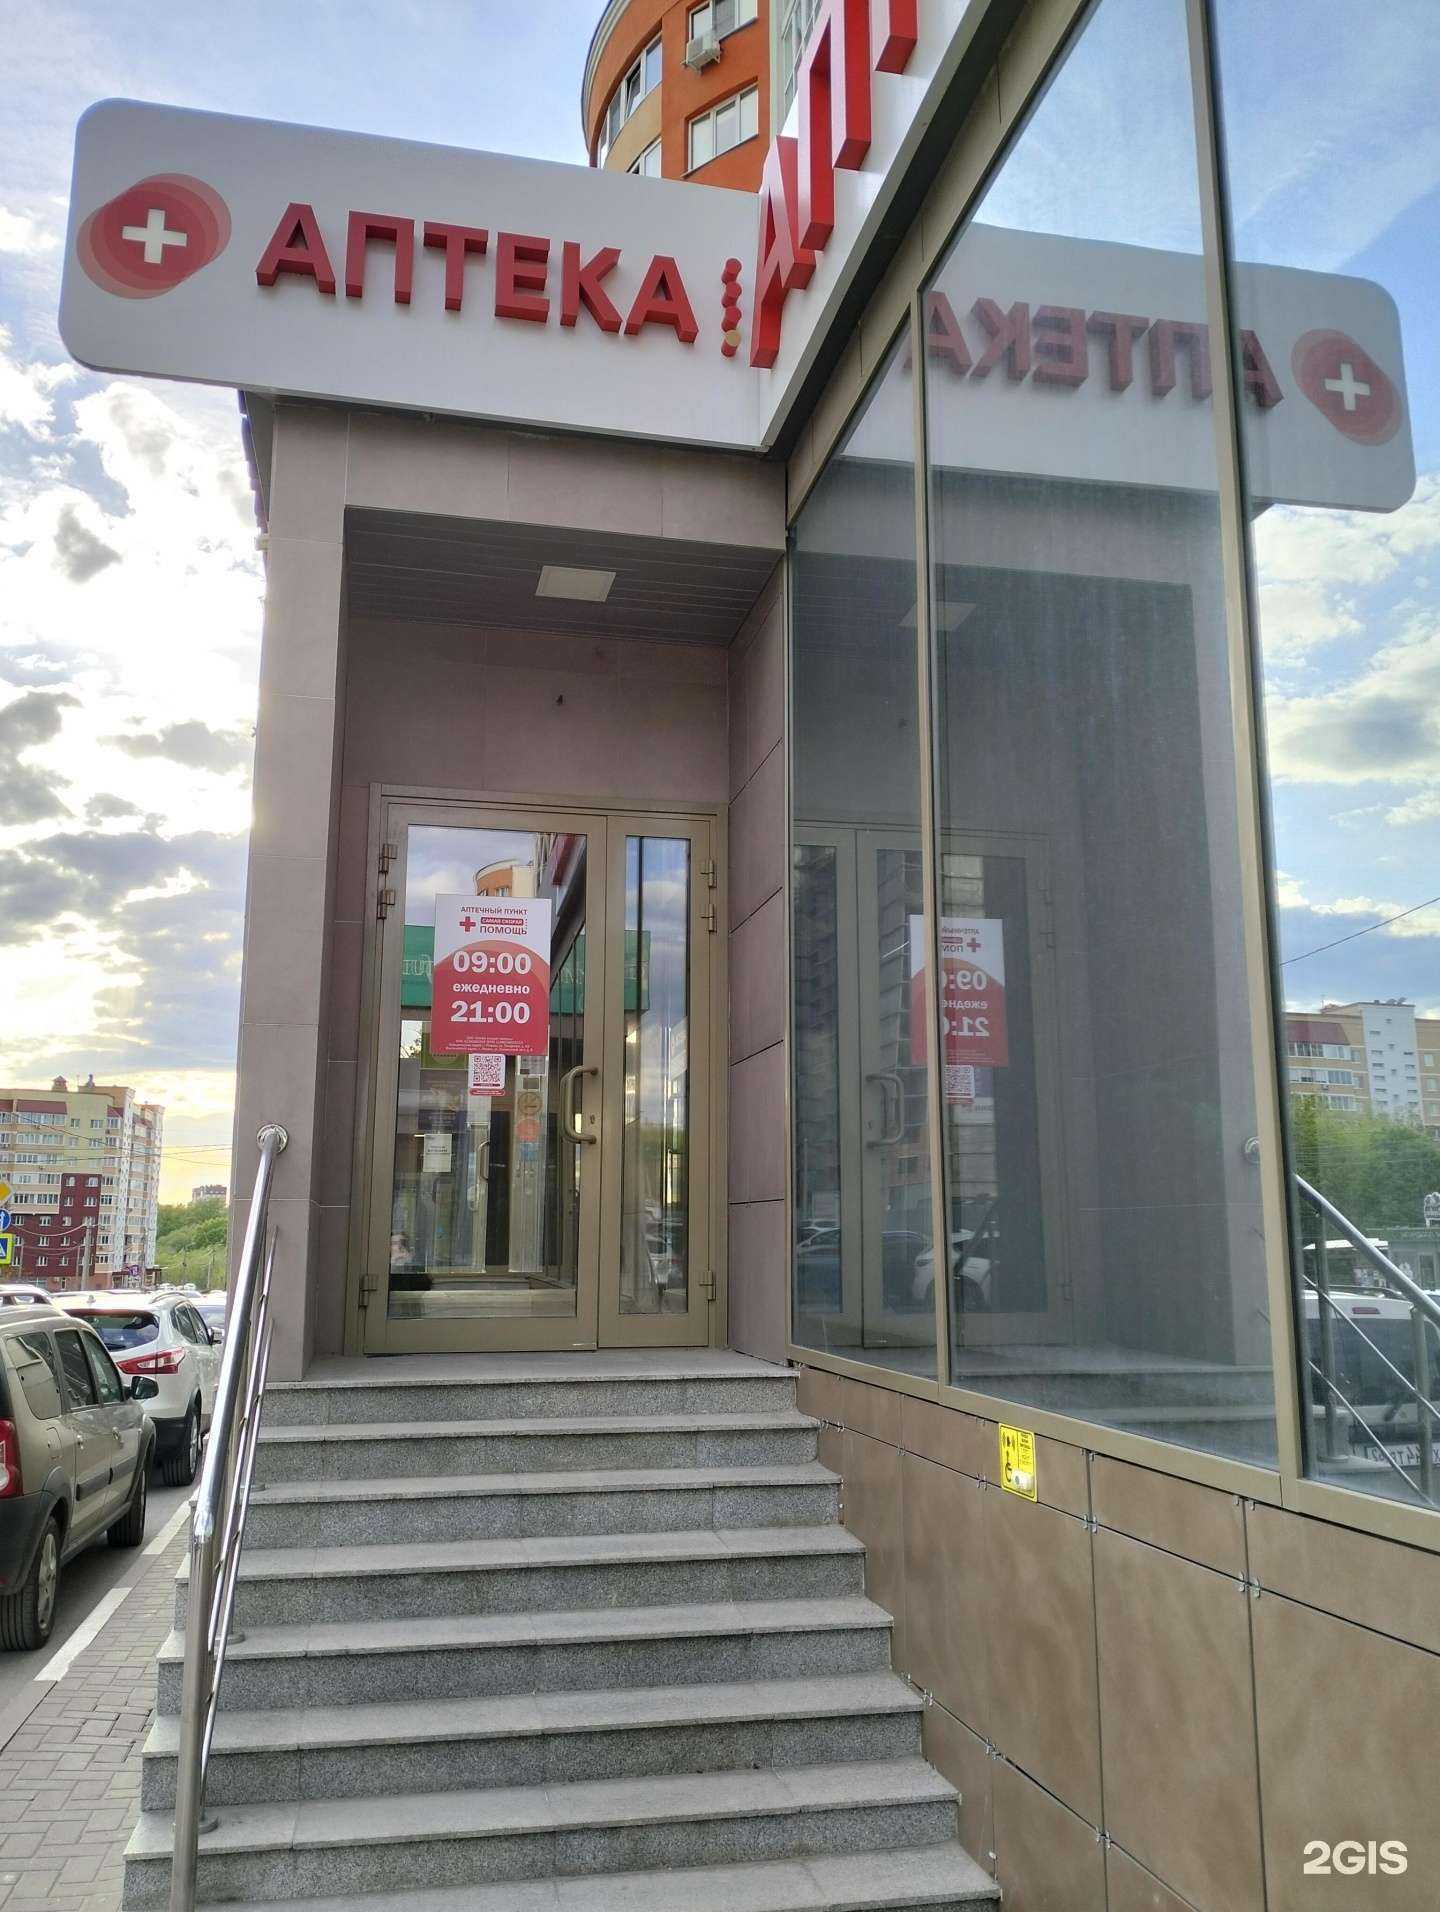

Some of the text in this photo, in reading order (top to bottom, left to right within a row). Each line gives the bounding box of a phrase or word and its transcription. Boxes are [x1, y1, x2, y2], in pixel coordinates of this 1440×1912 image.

[256, 202, 698, 344] АПТЕКА
[461, 906, 502, 915] АПТЕЧНЫЙ
[480, 925, 528, 935] ПОМОЩЬ
[452, 950, 532, 974] 09:00
[452, 983, 530, 995] ежедневно
[450, 1001, 531, 1024] 21:00
